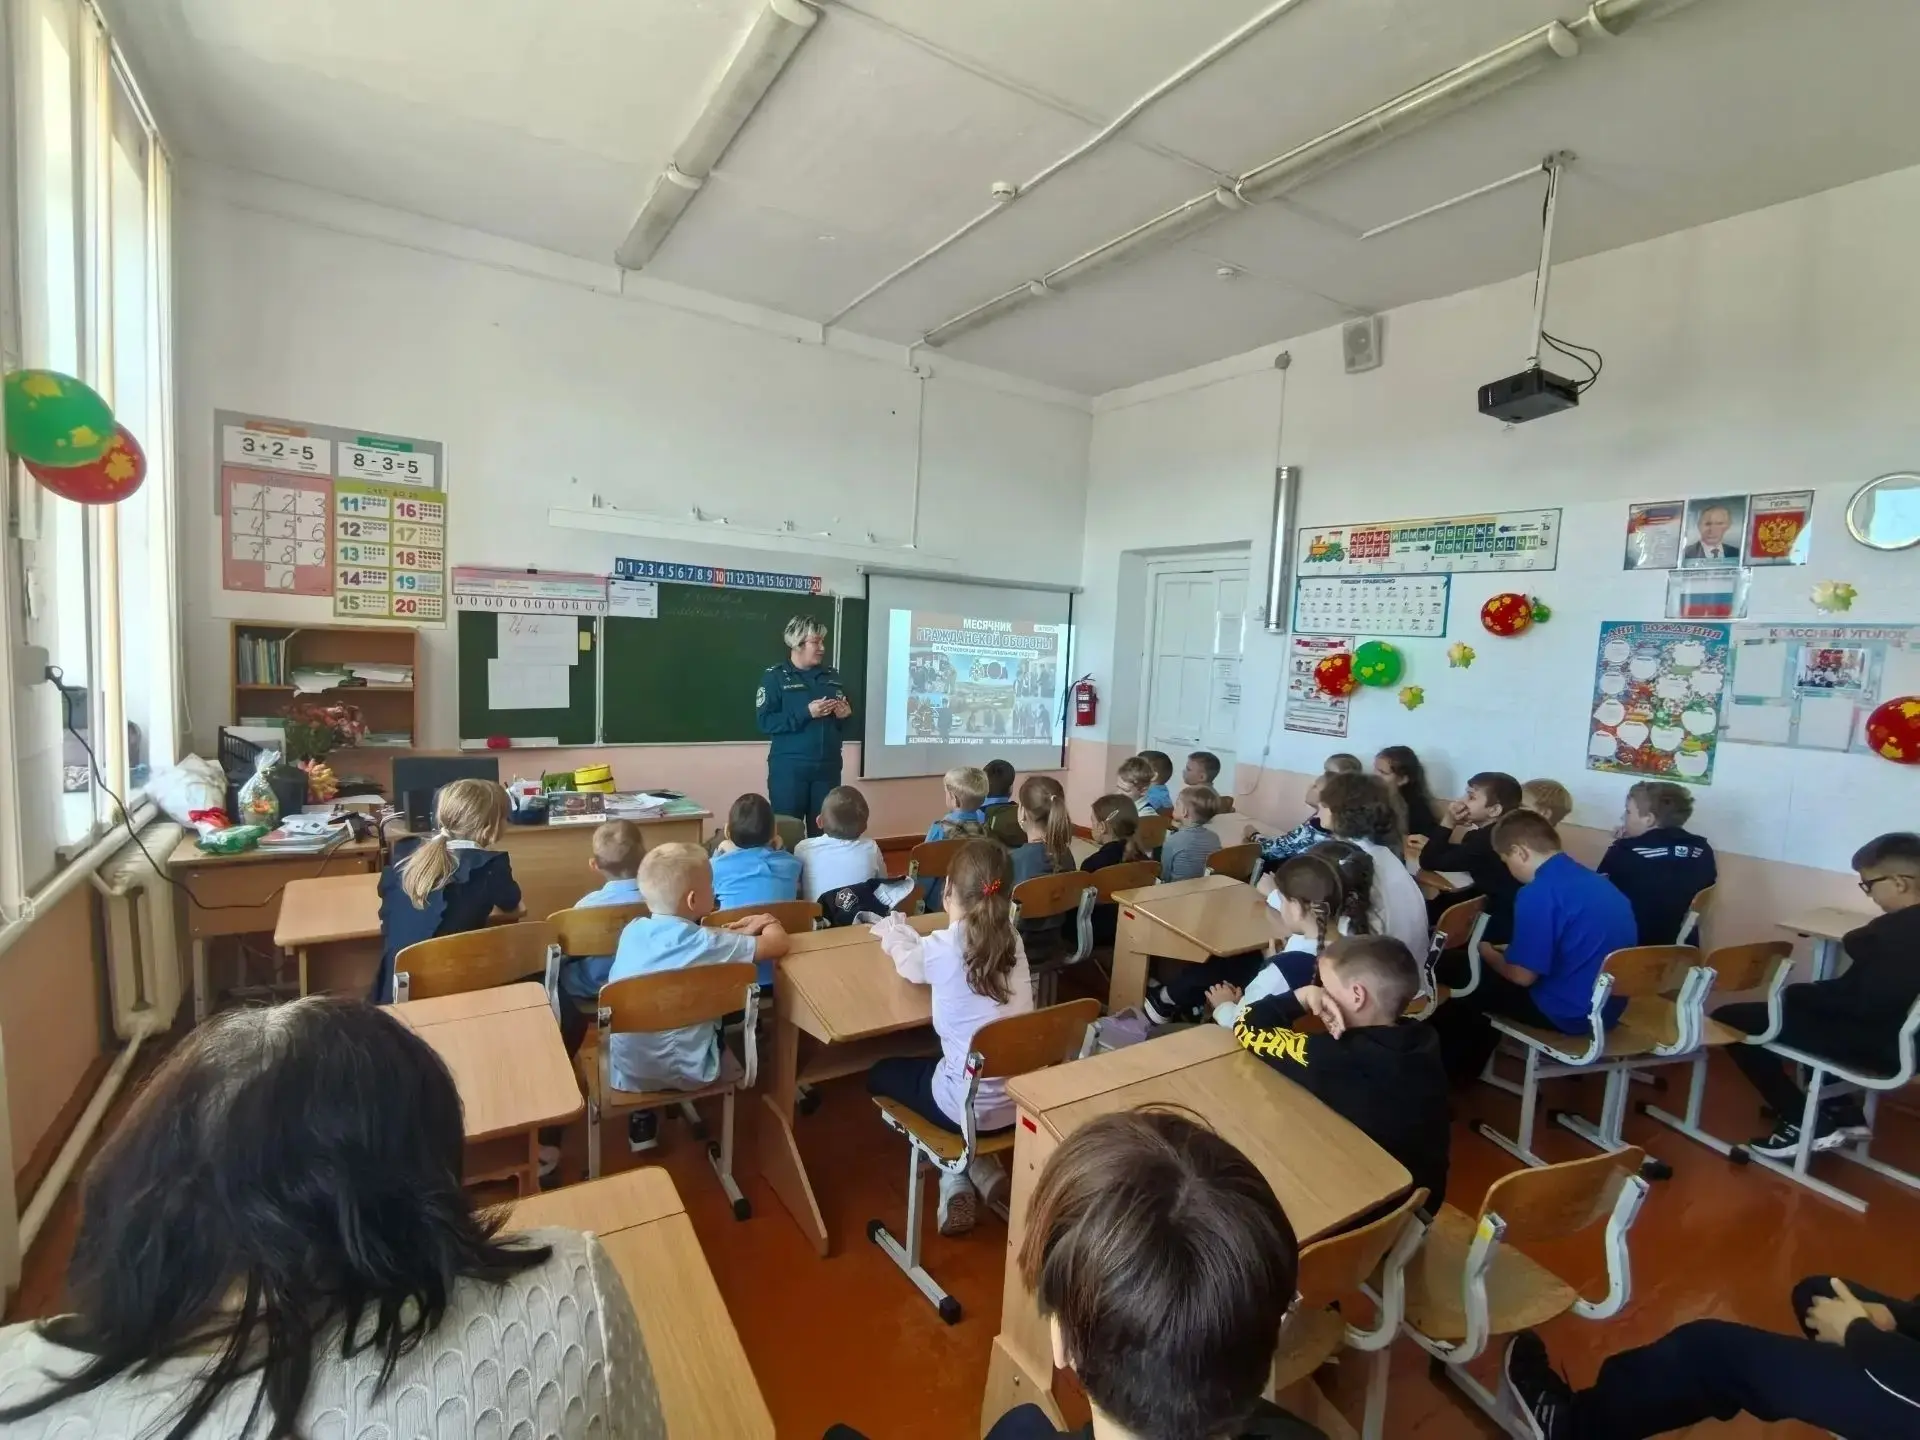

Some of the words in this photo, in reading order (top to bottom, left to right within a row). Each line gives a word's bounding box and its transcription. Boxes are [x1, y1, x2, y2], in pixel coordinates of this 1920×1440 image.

[243, 438, 255, 452] 3
[272, 442, 284, 456] 2
[302, 446, 314, 460] 5
[353, 453, 365, 466] 8
[382, 457, 393, 470] 3
[408, 460, 418, 473] 5
[340, 497, 358, 511] 11
[396, 503, 416, 517] 16
[312, 523, 325, 542] 6
[340, 521, 361, 537] 12
[396, 527, 417, 542] 17
[281, 545, 295, 564] 8
[340, 546, 359, 561] 13
[396, 551, 416, 565] 18
[340, 571, 361, 585] 14
[396, 575, 416, 589] 19
[617, 560, 624, 573] 0
[628, 562, 633, 573] 1
[638, 563, 644, 574] 2
[648, 563, 654, 575] 3
[658, 564, 664, 576] 4
[668, 566, 674, 577] 5
[678, 567, 684, 578] 6
[688, 568, 693, 579] 7
[697, 569, 703, 580] 8
[707, 570, 712, 580] 9
[715, 570, 724, 582] 10
[726, 572, 734, 583] 11
[736, 572, 744, 584] 12
[746, 573, 754, 585] 13
[757, 574, 764, 586] 14
[766, 575, 774, 586] 15
[776, 576, 784, 587] 16
[786, 577, 793, 588] 17
[795, 578, 803, 588] 18
[804, 578, 811, 589] 19
[813, 579, 821, 590] 20
[339, 595, 360, 610] 15
[395, 599, 417, 613] 20
[963, 618, 1012, 632] МЕСЯЧНИК
[917, 627, 1000, 647] ГРАЖДАНСКОЙ
[1002, 634, 1053, 650] ОБОРОНЫ
